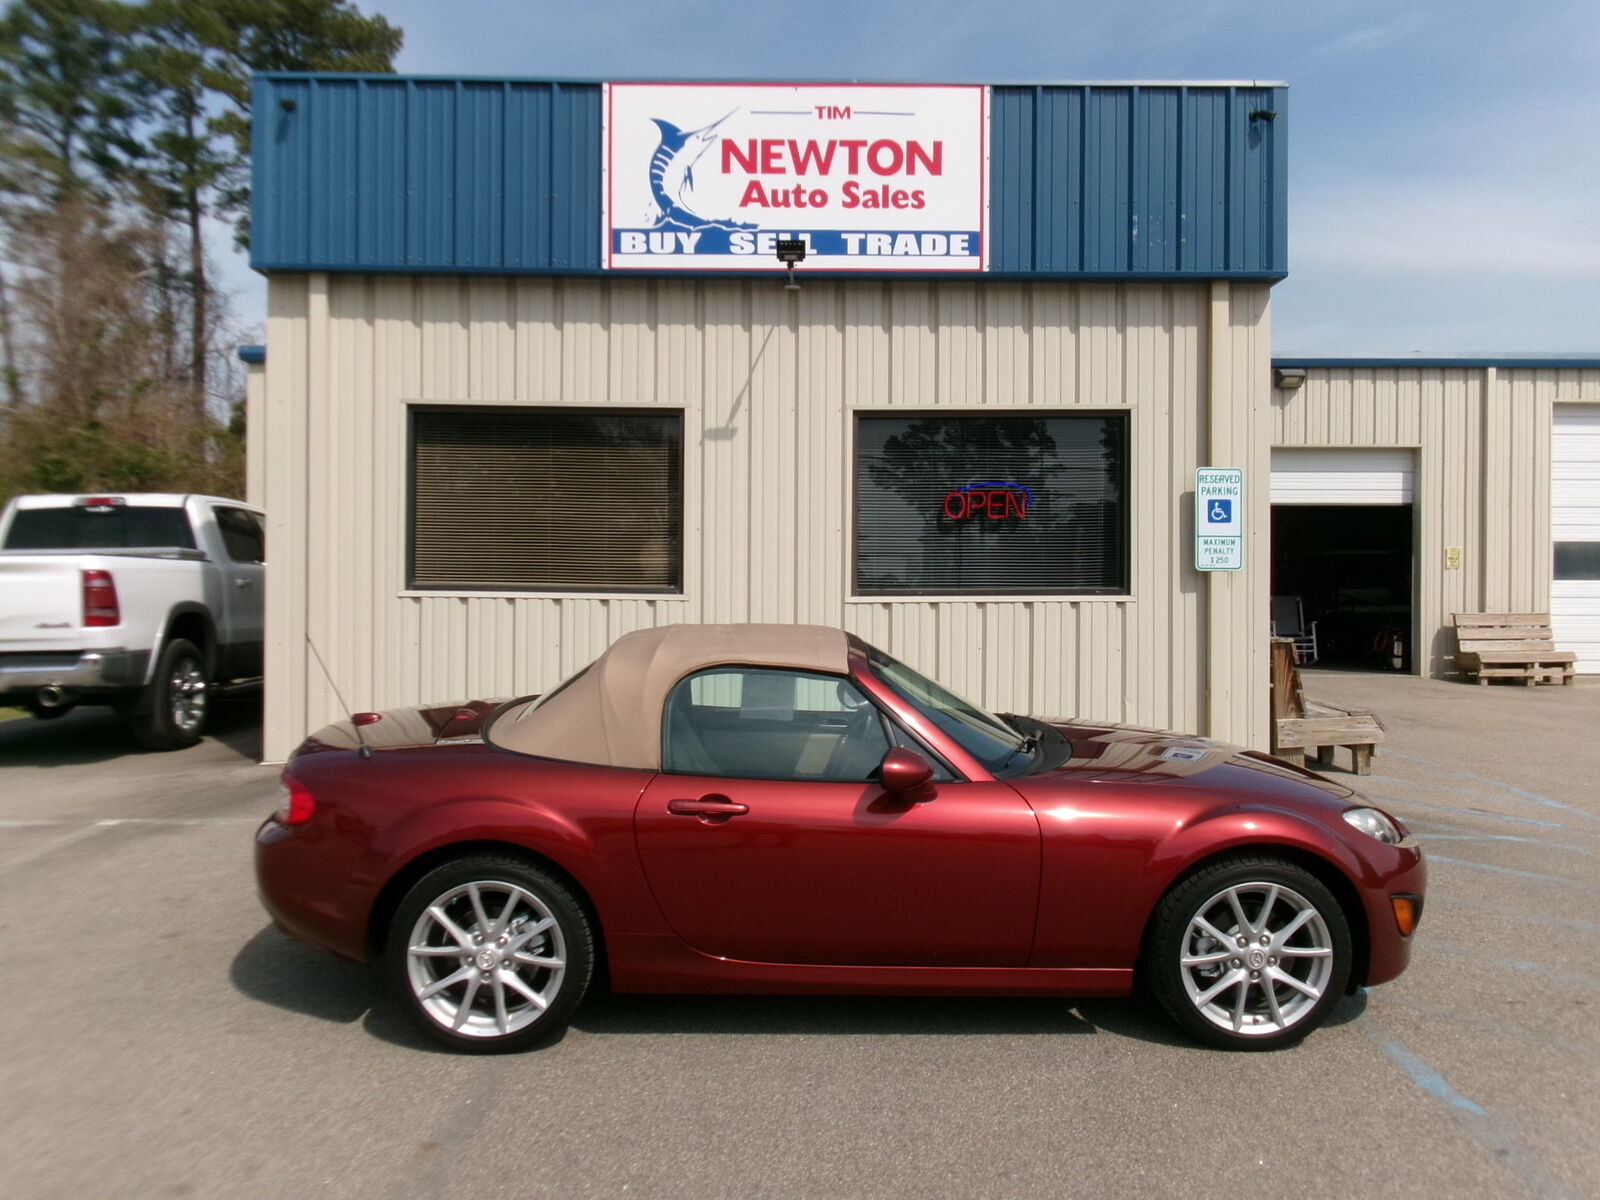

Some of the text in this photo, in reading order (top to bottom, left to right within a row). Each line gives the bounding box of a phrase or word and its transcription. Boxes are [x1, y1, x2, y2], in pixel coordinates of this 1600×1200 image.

[814, 105, 852, 120] TIM
[720, 138, 943, 177] NEWTON
[738, 179, 926, 210] Auto Sales
[620, 232, 702, 254] BUY
[841, 233, 970, 256] TRADE
[1199, 474, 1240, 484] RESERVED
[1201, 486, 1239, 496] PARKING
[944, 491, 1027, 519] OPEN
[1203, 538, 1236, 546] MAXIMUM
[1204, 547, 1235, 555] PENALTY
